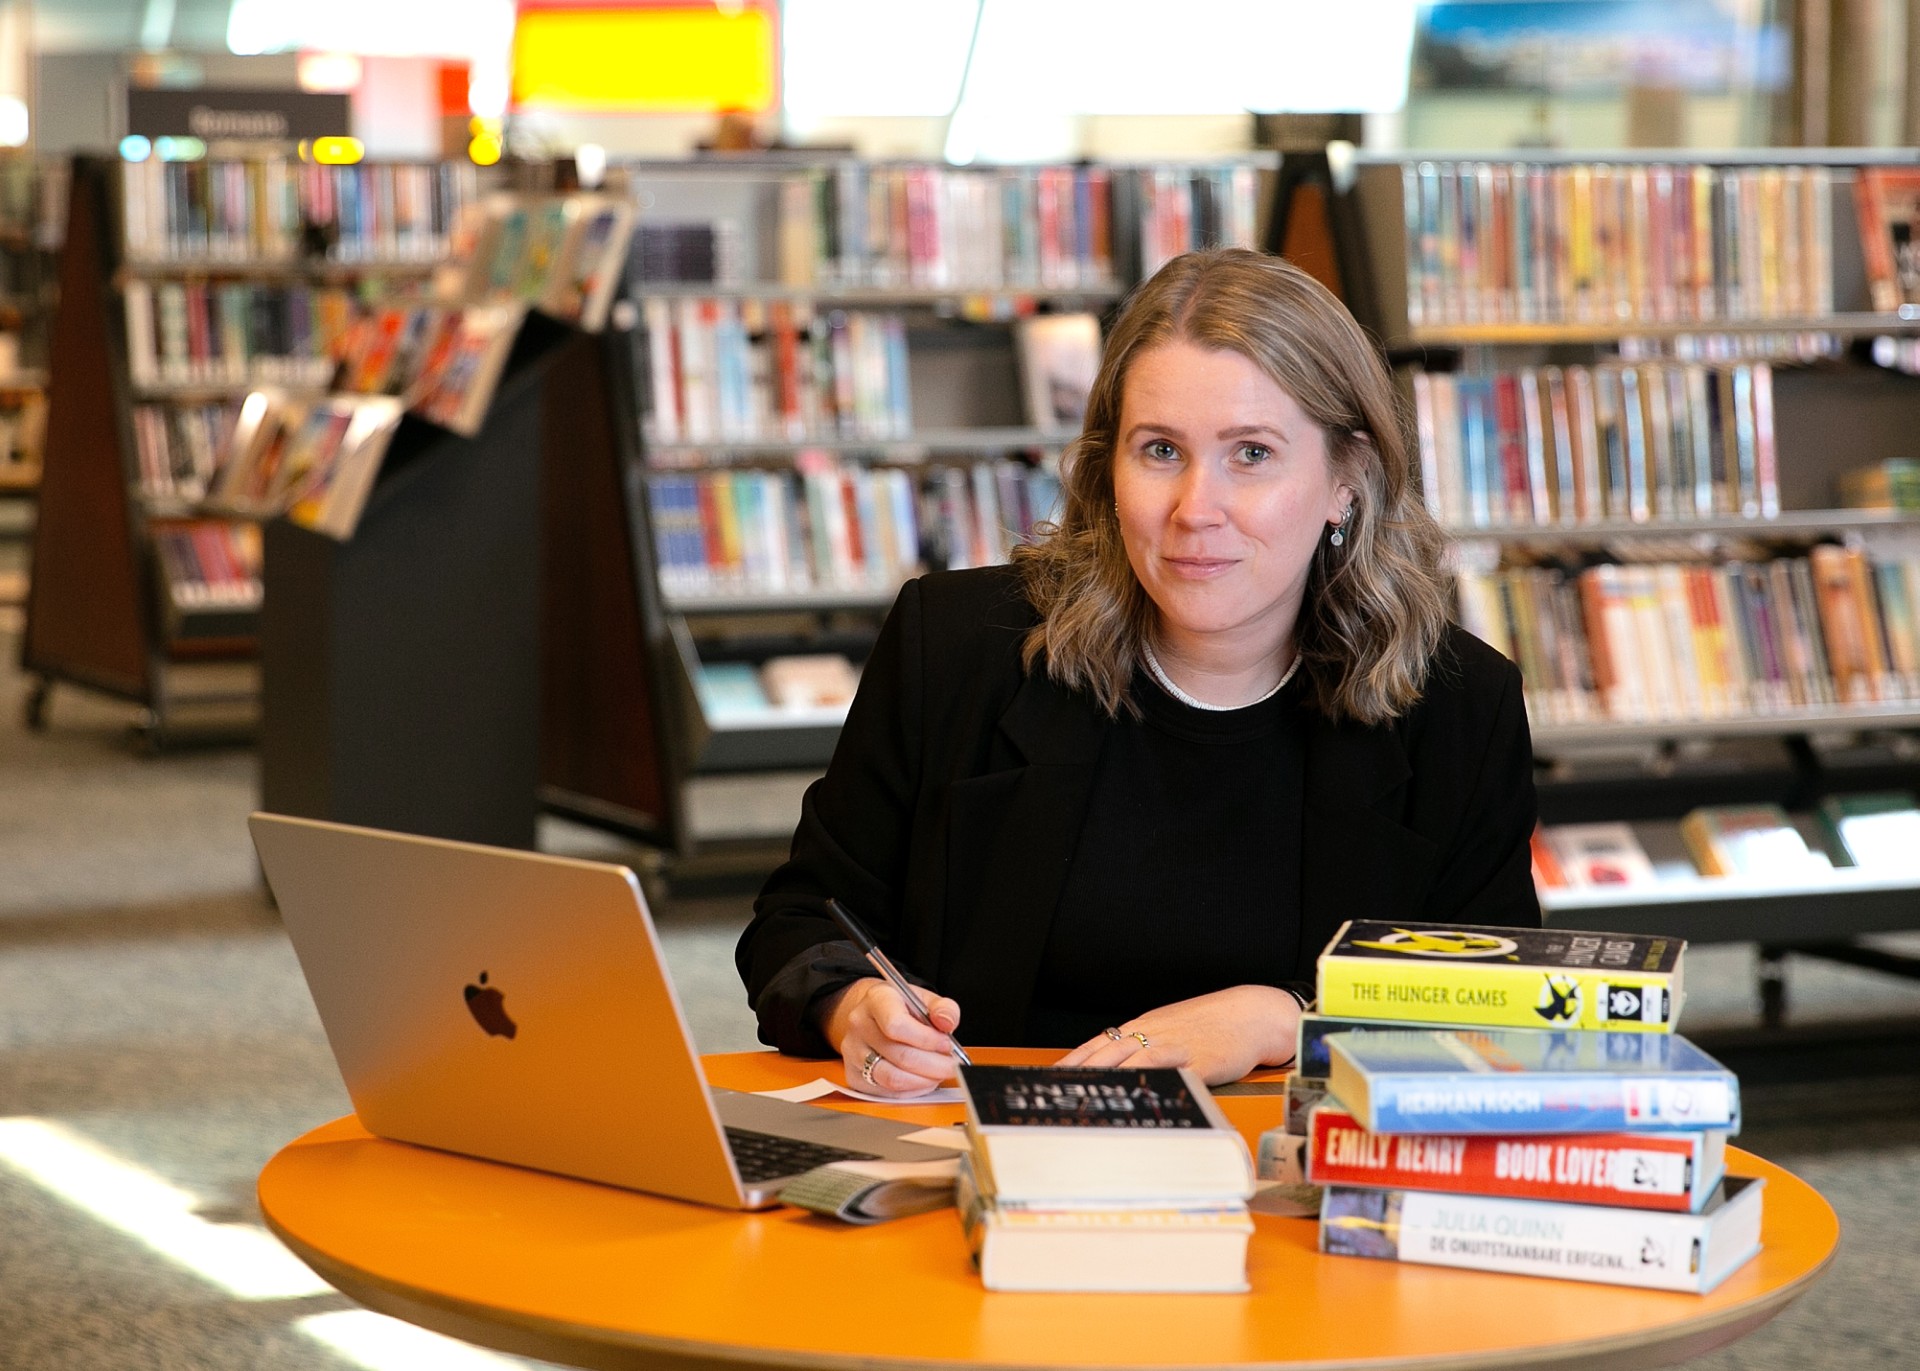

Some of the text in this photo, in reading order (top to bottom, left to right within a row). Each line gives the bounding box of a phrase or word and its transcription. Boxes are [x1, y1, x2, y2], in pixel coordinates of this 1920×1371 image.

[1351, 982, 1508, 1008] THE HUNGER GAMES
[1483, 1087, 1541, 1113] KOCH
[1325, 1127, 1620, 1188] EMILY HENRY BOOK LOVER
[1431, 1209, 1565, 1241] JULIA QUINN
[1429, 1235, 1447, 1253] DE
[1449, 1237, 1563, 1264] ONUITSTAANBARE
